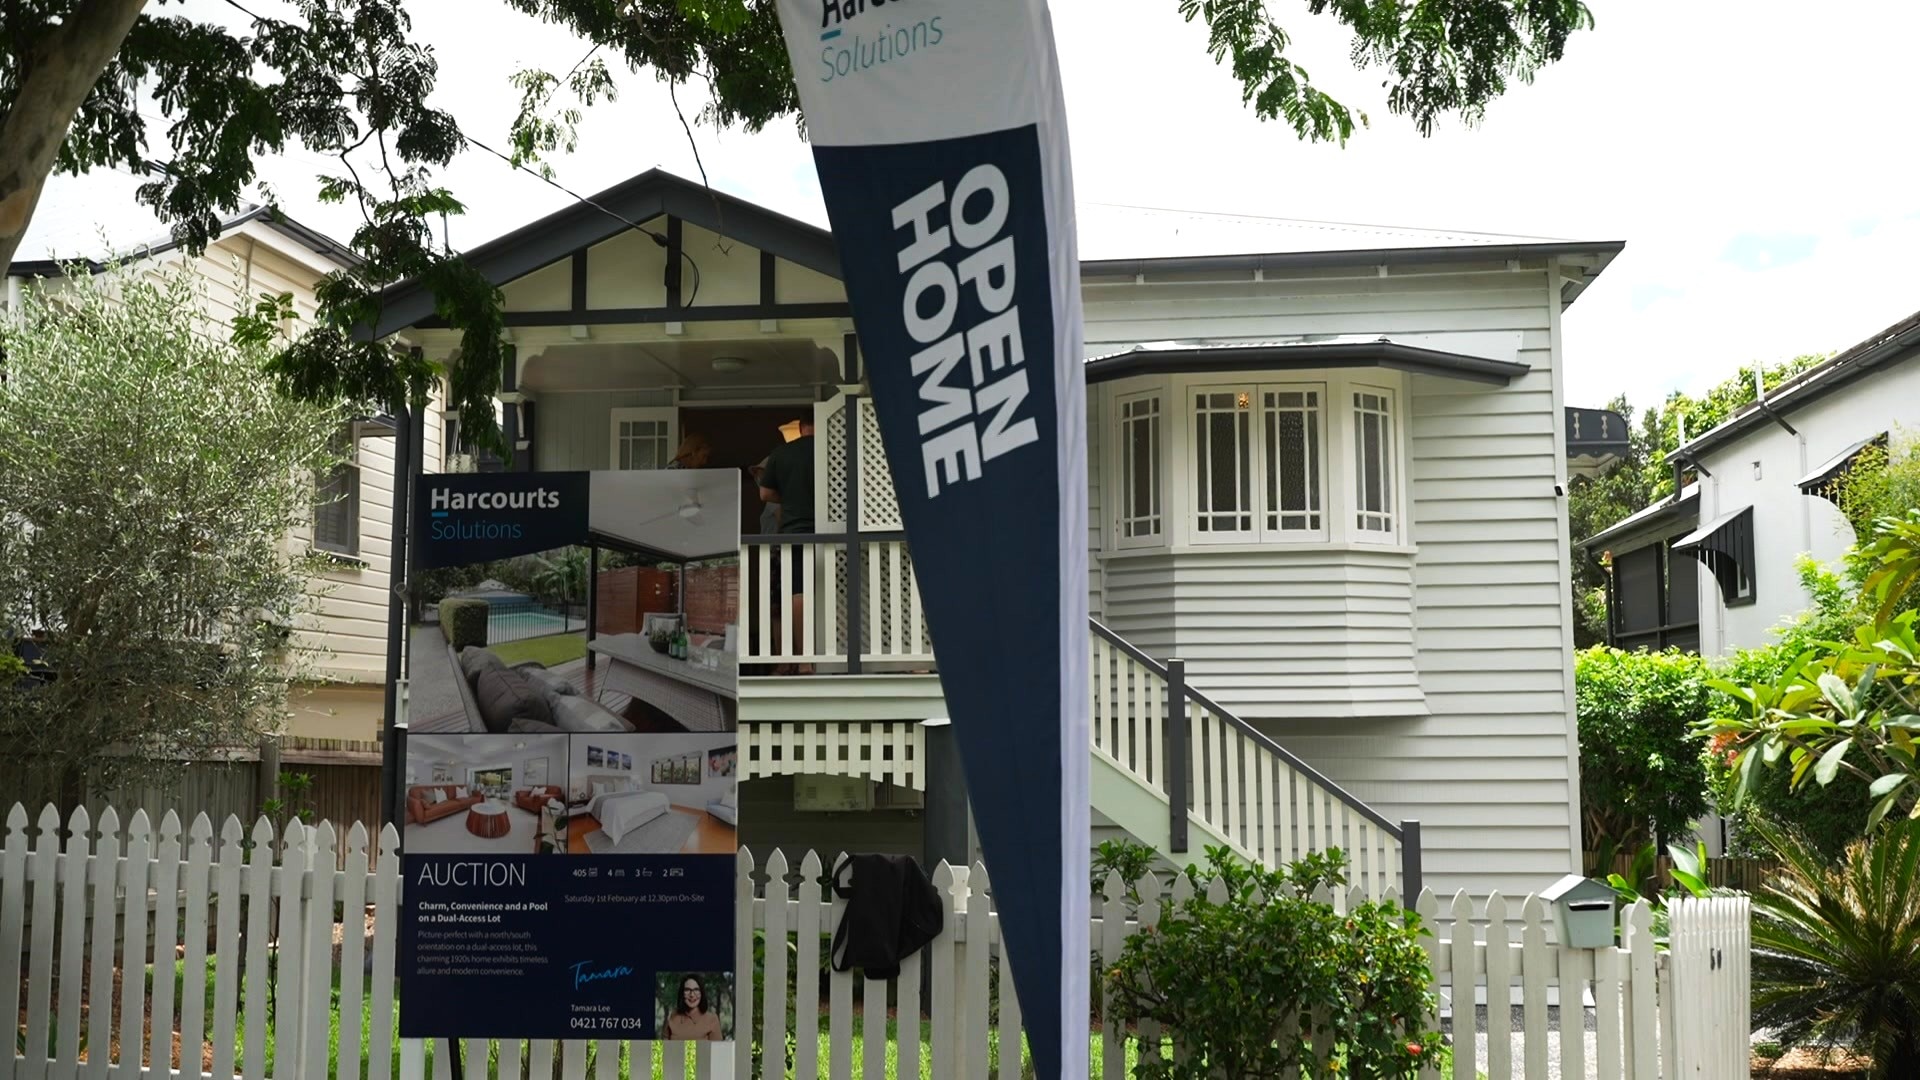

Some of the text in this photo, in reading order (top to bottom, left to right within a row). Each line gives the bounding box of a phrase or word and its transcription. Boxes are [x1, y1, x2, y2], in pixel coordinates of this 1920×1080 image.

[822, 16, 942, 82] Solutions
[950, 163, 1039, 462] OPEN
[891, 180, 982, 500] HOME
[431, 488, 560, 510] Harcourts
[431, 520, 522, 540] Solutions
[418, 862, 525, 886] AUCTION
[573, 869, 667, 877] 405 4 3 2
[565, 894, 595, 903] Saturday
[608, 894, 638, 903] February
[679, 894, 705, 902] On-Site
[419, 902, 449, 912] Charm,
[450, 902, 503, 911] Convenience
[505, 902, 521, 910] and
[529, 902, 548, 911] Pool
[437, 914, 485, 923] Dual-Access
[487, 914, 501, 923] Lot
[418, 930, 467, 939] Picture-perfect
[469, 930, 483, 938] with
[490, 931, 531, 939] north/south
[417, 943, 454, 951] orientation
[513, 944, 523, 952] lot,
[417, 955, 450, 964] charming
[417, 966, 436, 975] allure
[437, 967, 451, 975] and
[452, 967, 479, 975] modern
[569, 960, 632, 990] Tamara
[571, 1004, 610, 1012] Tamara Lee
[570, 1018, 641, 1029] 0421 767 034
